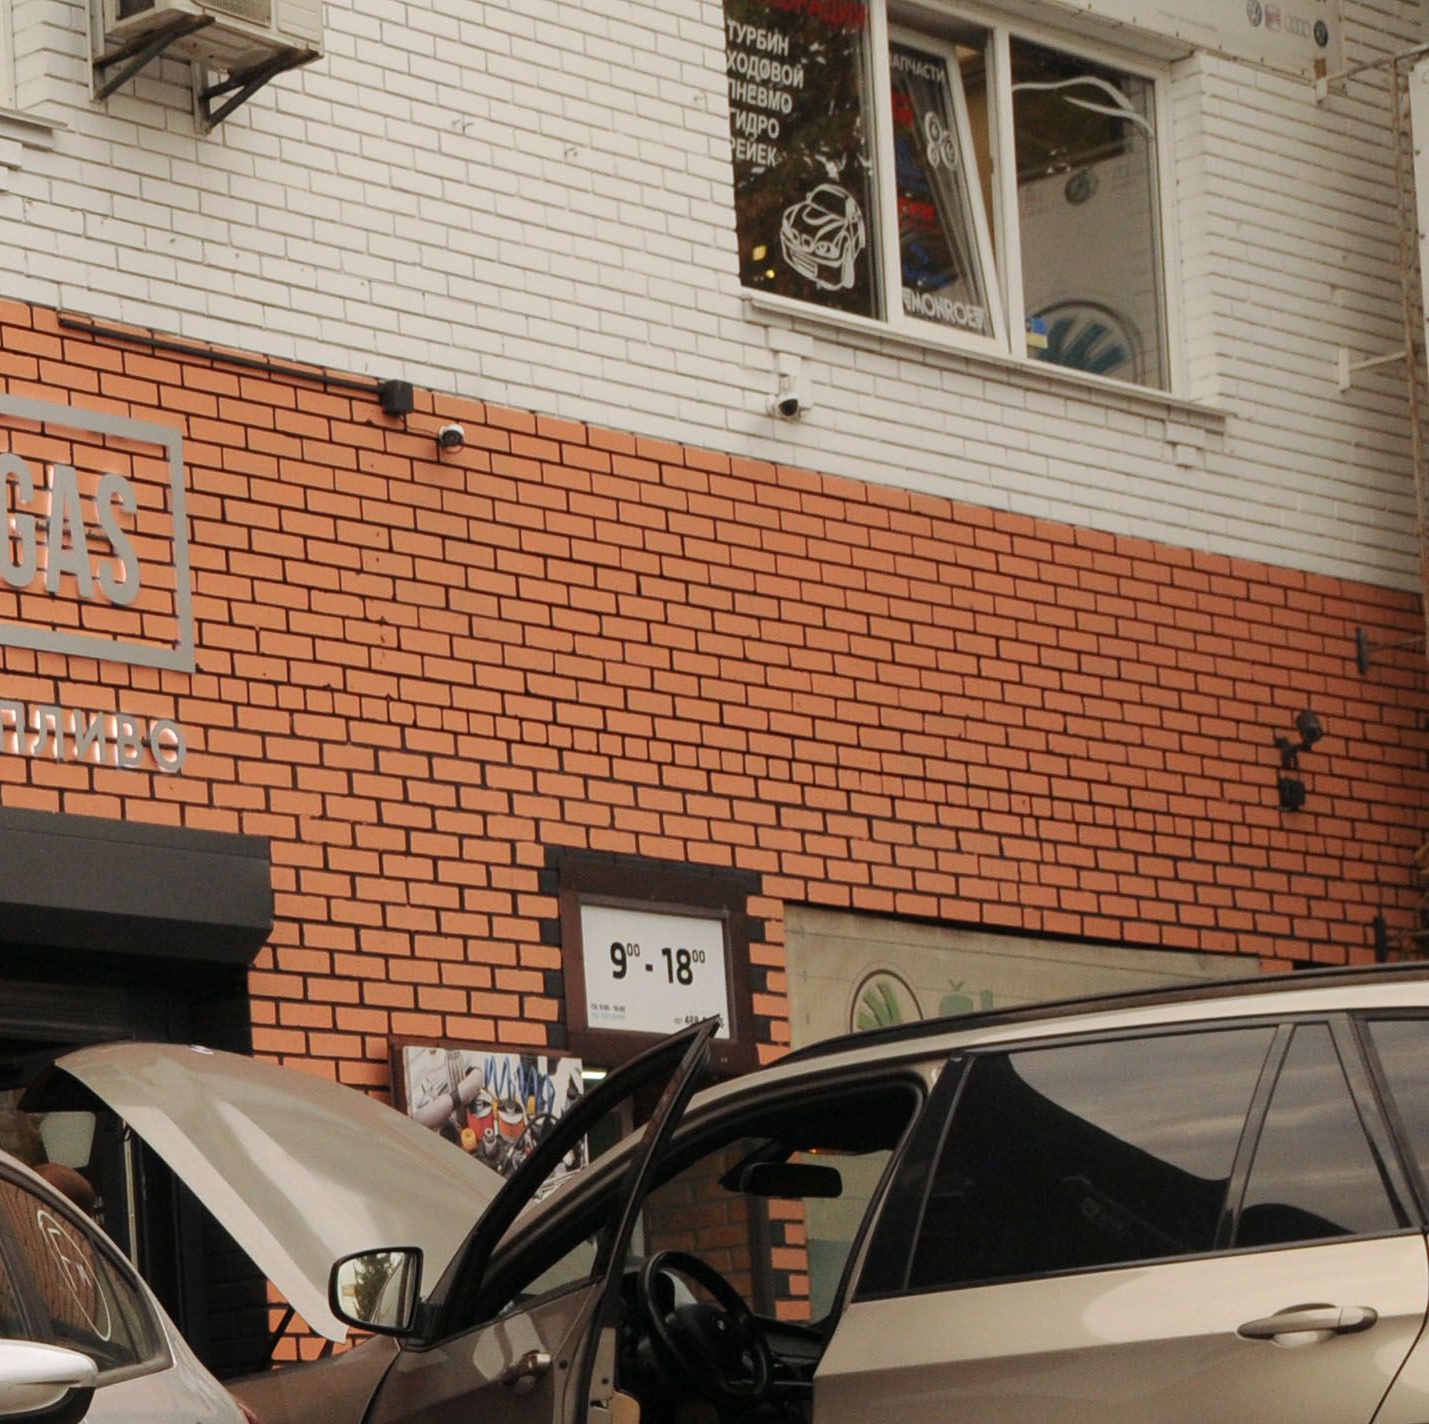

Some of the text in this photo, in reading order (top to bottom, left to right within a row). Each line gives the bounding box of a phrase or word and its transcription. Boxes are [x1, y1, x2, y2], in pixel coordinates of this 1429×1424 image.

[727, 18, 789, 56] ТУРБИН
[726, 49, 804, 90] ХОДОВОЙ
[910, 288, 975, 327] MONROE
